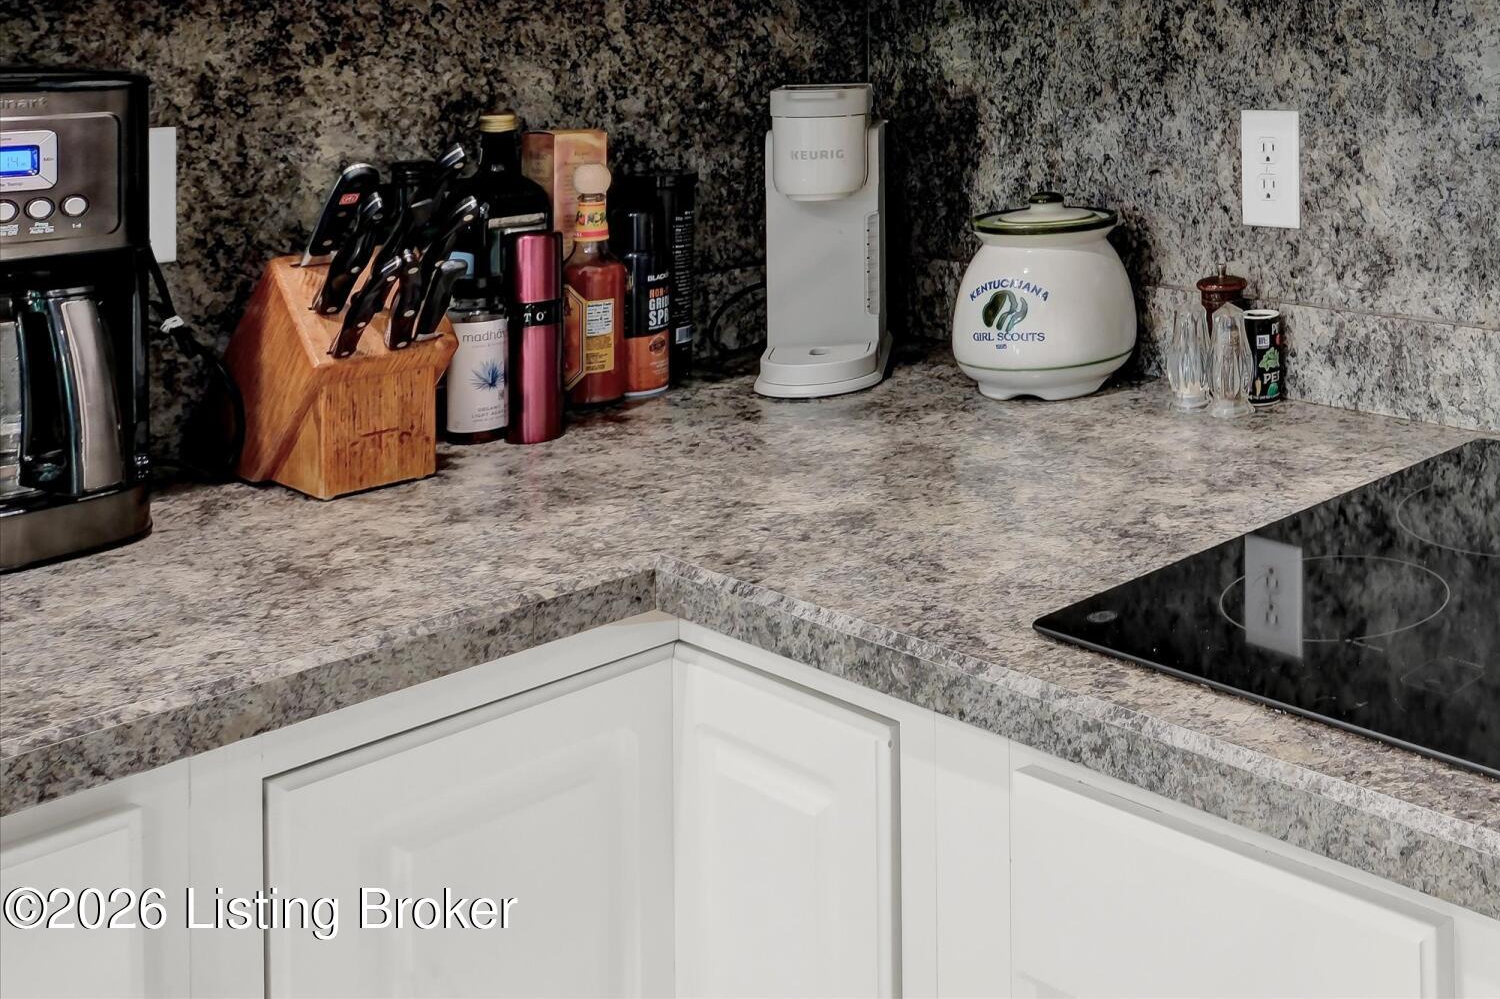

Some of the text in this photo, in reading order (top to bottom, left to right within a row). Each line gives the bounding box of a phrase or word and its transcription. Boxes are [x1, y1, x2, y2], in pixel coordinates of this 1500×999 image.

[790, 149, 845, 161] KEURIG
[972, 332, 1046, 342] GIRL SCOUTS
